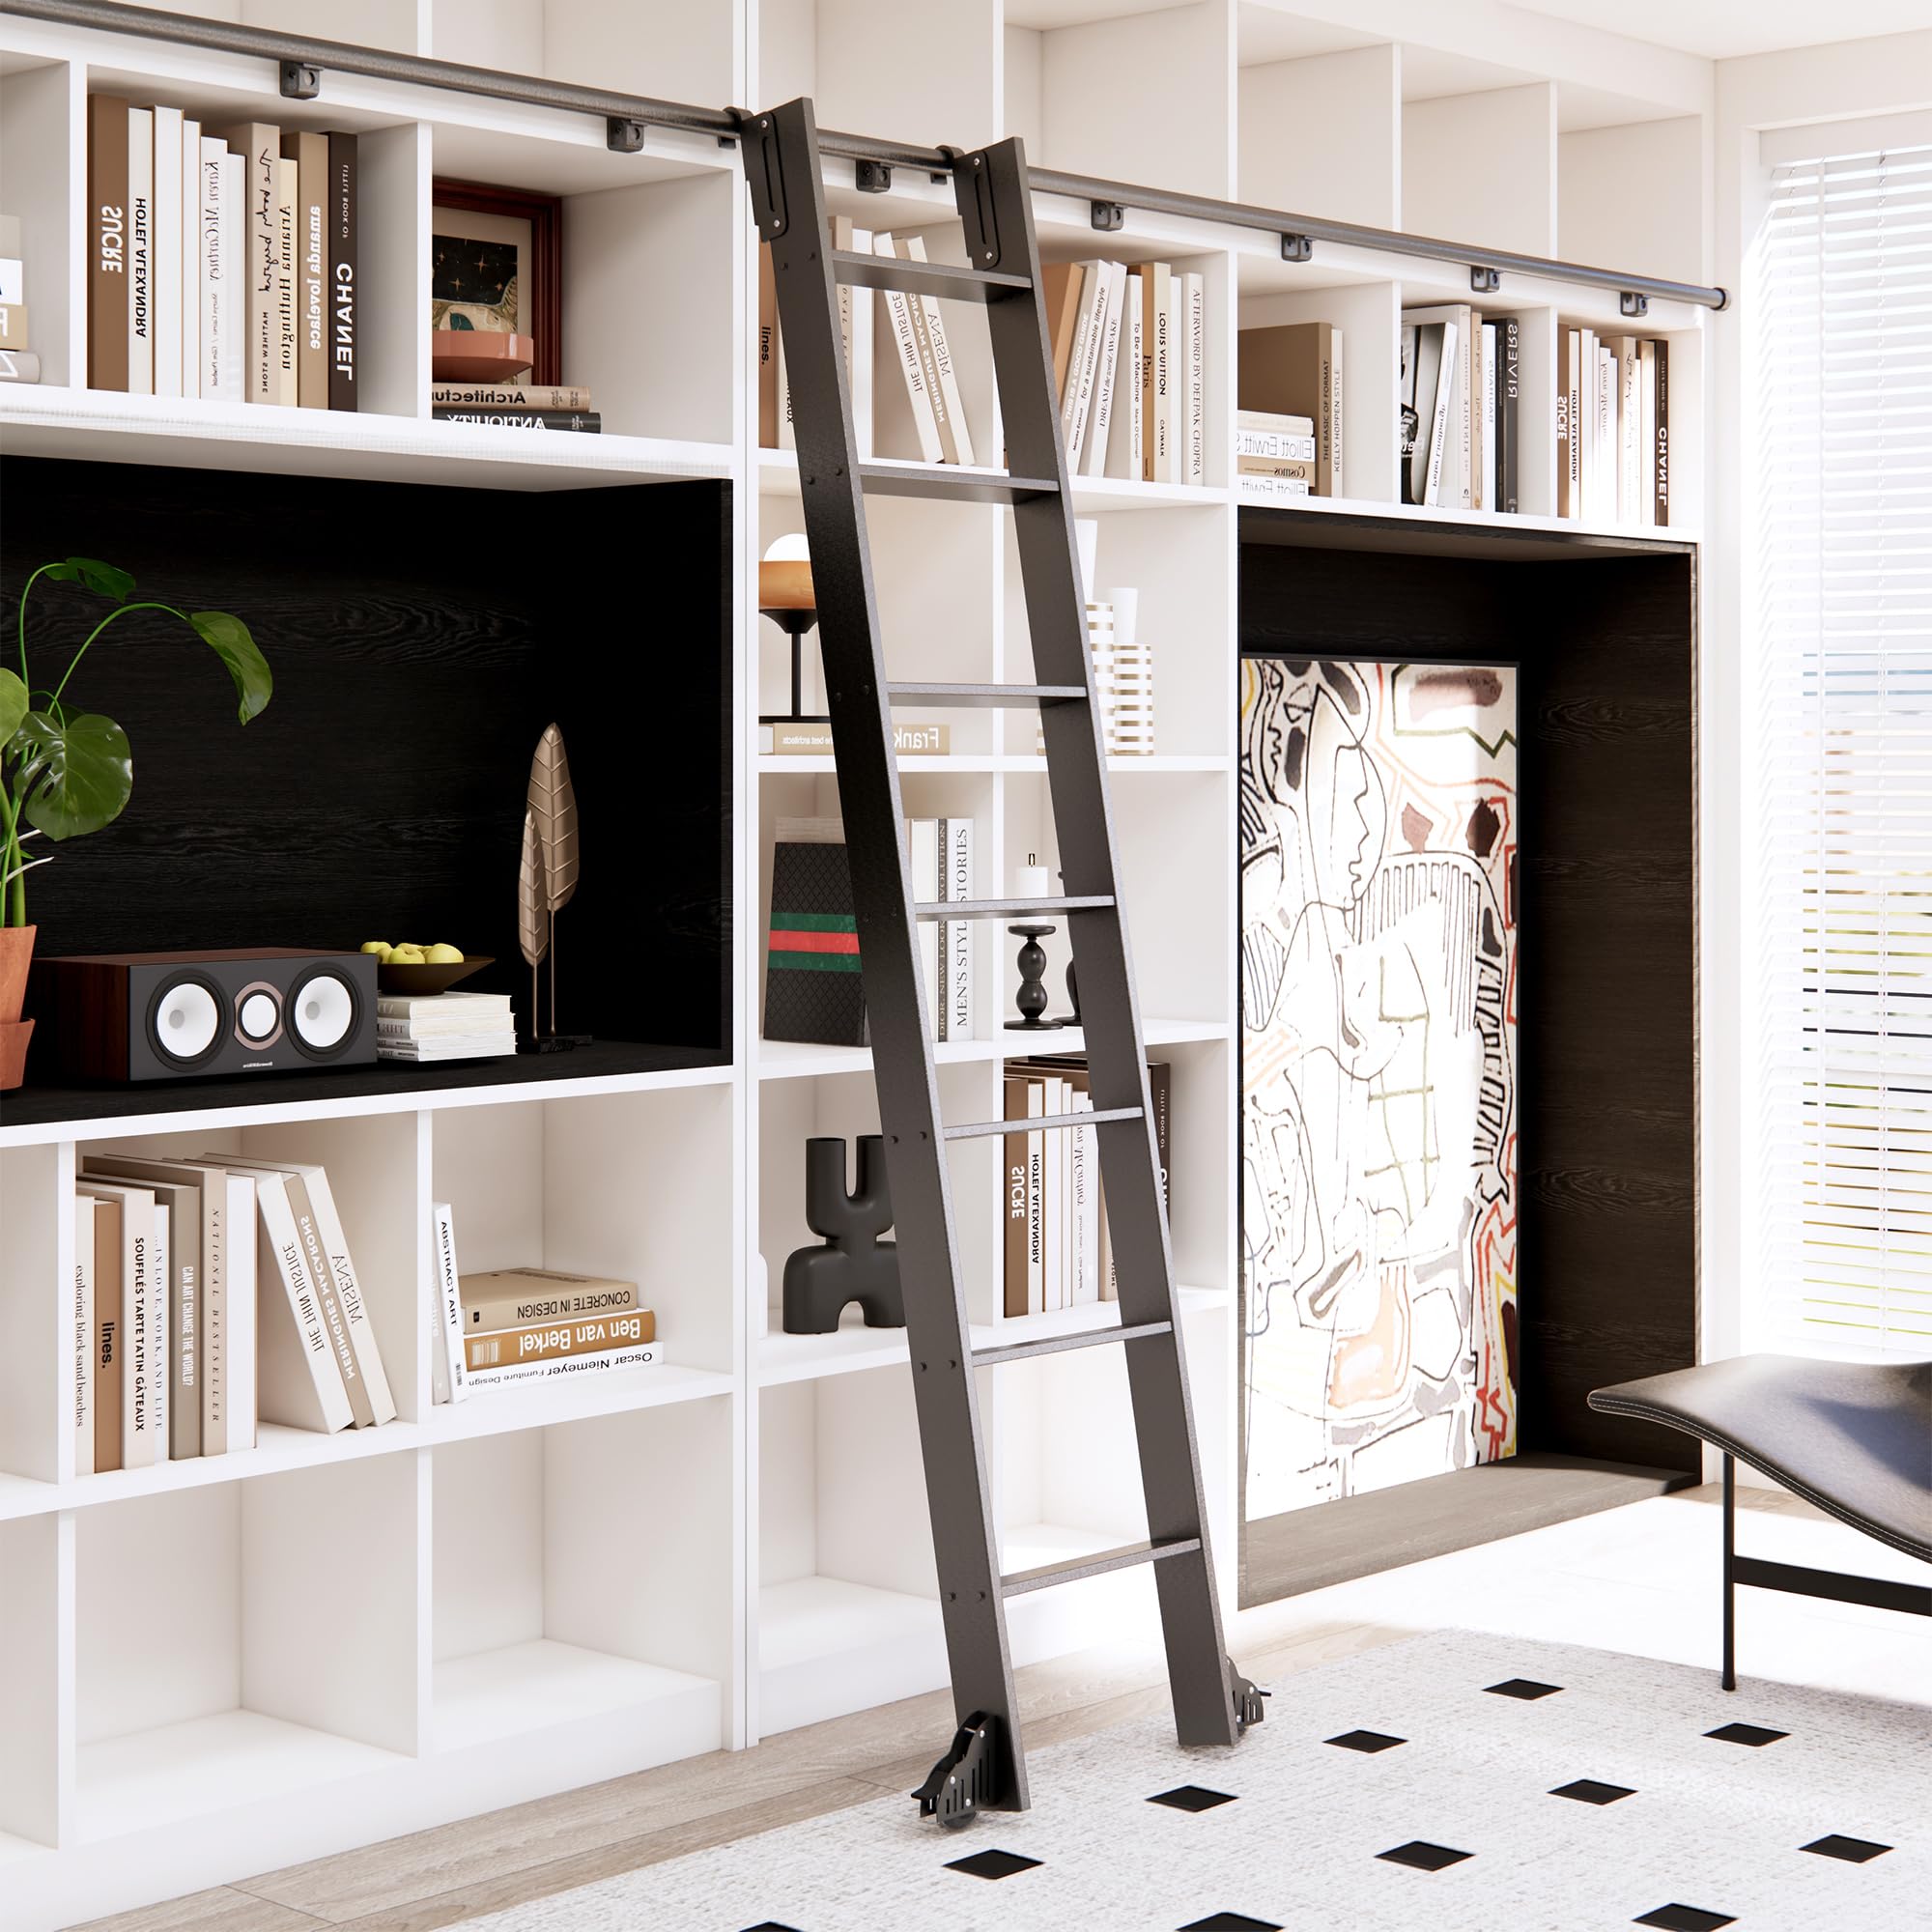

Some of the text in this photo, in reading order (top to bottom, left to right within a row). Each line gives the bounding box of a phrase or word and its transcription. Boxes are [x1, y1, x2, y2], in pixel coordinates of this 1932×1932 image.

[1094, 286, 1106, 323] lifestyle
[761, 327, 772, 365] lines.
[1134, 323, 1140, 334] To
[1134, 336, 1140, 350] Be
[1084, 325, 1099, 376] sustainable
[1098, 387, 1110, 427] DREAM
[1108, 319, 1119, 355] AWAKE
[1143, 355, 1152, 388] Paris
[1192, 288, 1201, 477] AFTERWORD BY DEEPAK CHOPRA
[1080, 386, 1090, 400] for
[956, 829, 968, 1027] MEN'S STYL STORIES
[75, 1265, 86, 1319] exploring
[440, 1221, 458, 1326] ABSTRACT ART
[518, 1291, 631, 1320] CONCRETE IN DESIGN
[75, 1321, 86, 1351] black
[135, 1237, 147, 1432] SOUFFLÉS TARTE TATIN GÂTEAUX
[182, 1265, 193, 1387] CAN ART CHANGE THE WORLD?
[518, 1318, 641, 1356] Ben van Berkel
[101, 1321, 114, 1370] lines.
[613, 1352, 653, 1367] Oscar
[469, 1374, 500, 1388] Design
[503, 1370, 545, 1381] Furniture
[547, 1358, 611, 1378] Niemeyer
[75, 1381, 86, 1428] beaches
